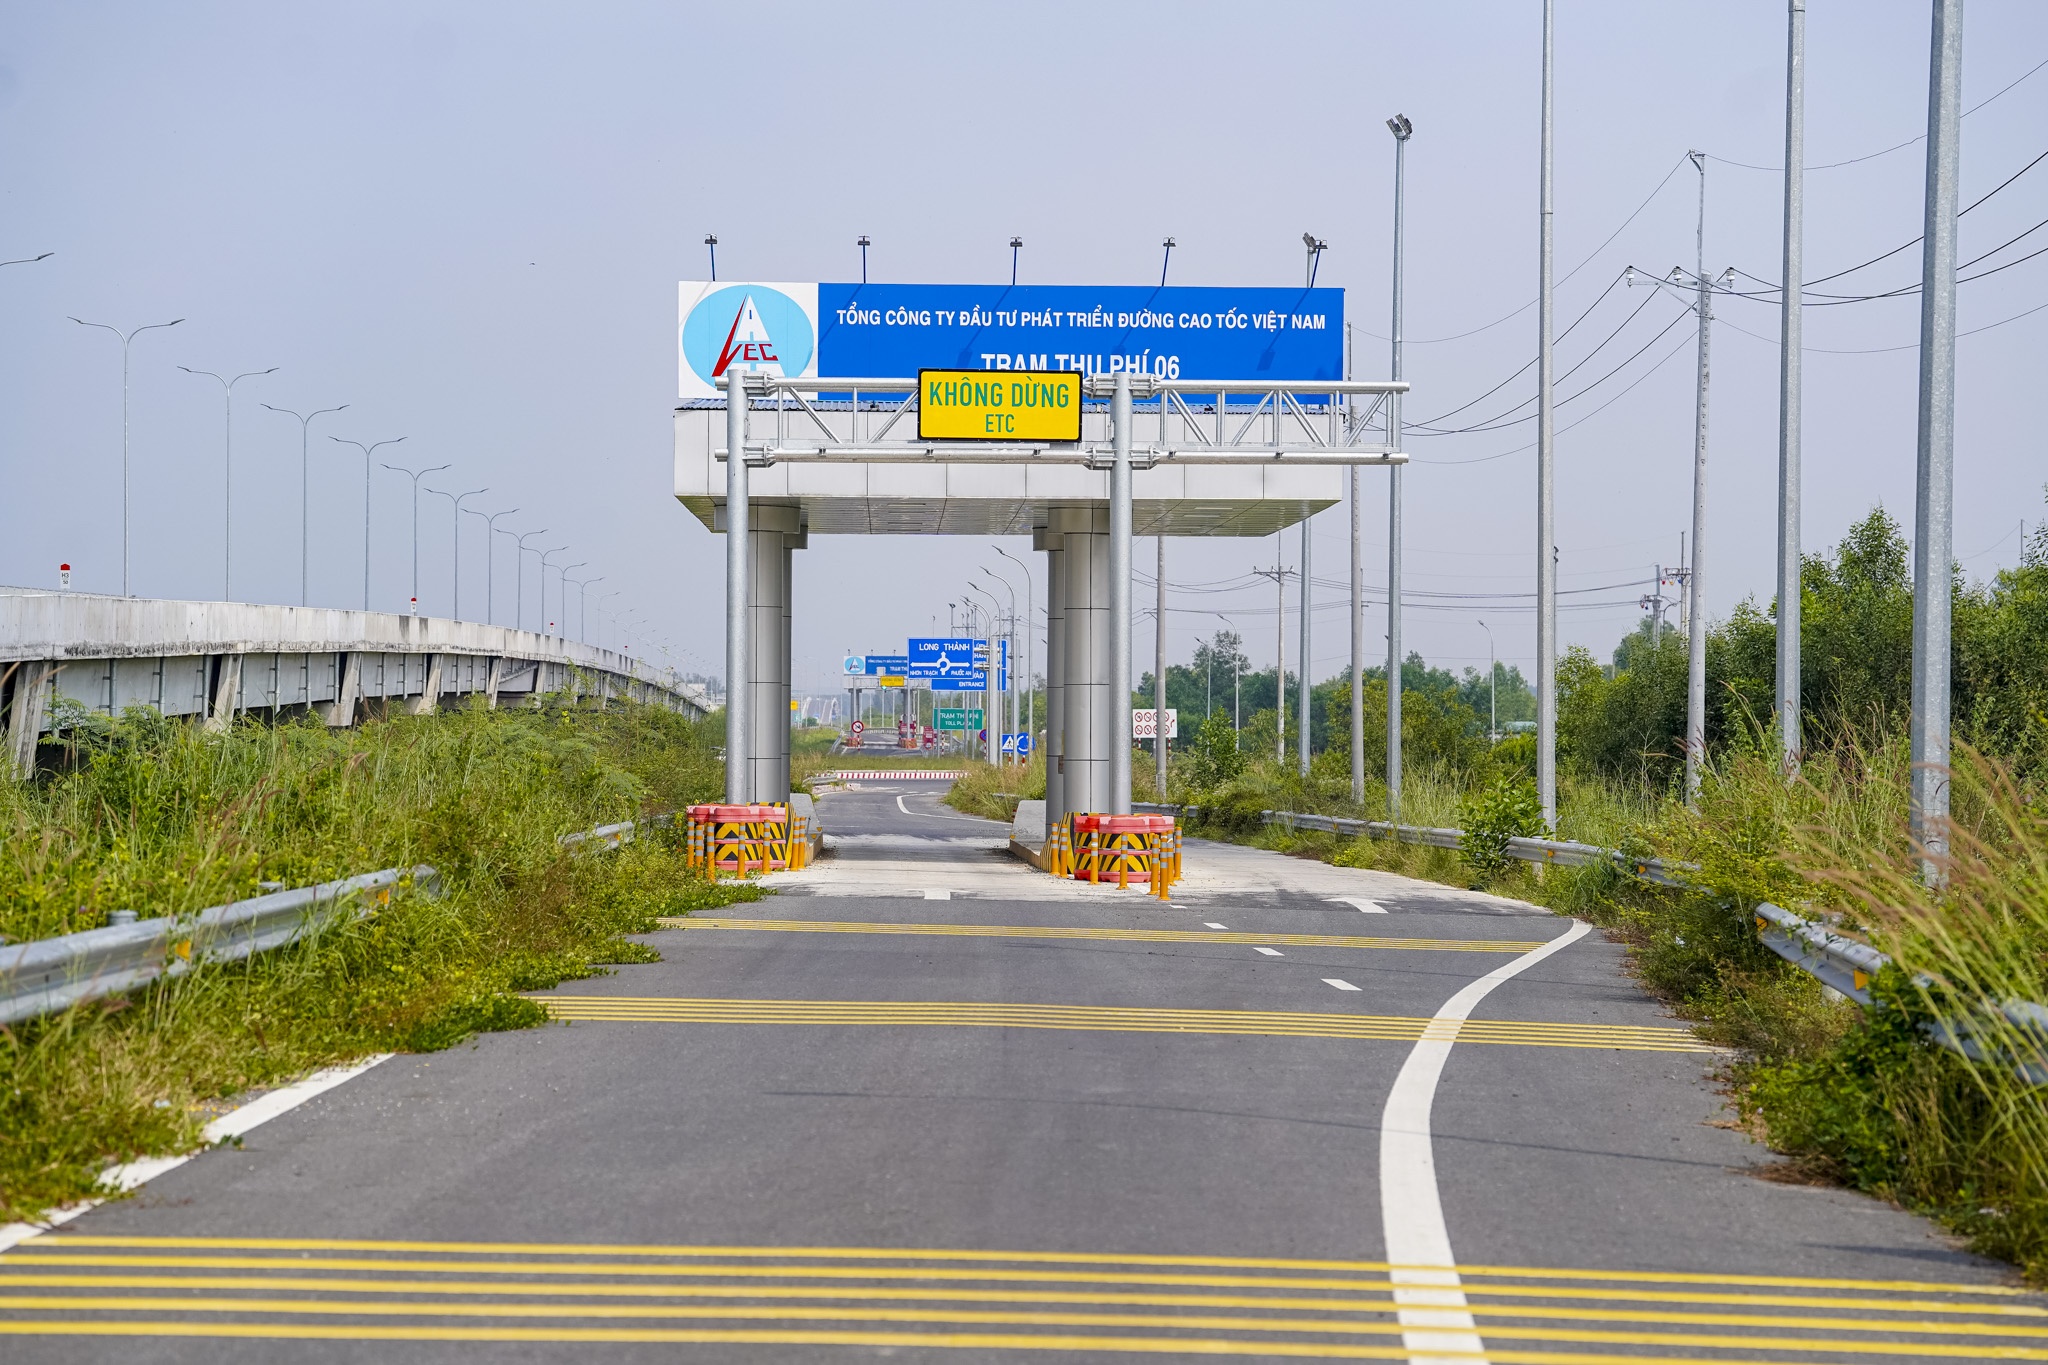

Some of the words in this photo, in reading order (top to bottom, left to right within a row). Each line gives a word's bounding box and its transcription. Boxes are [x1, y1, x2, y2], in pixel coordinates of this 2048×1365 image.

[836, 301, 881, 326] TỔNG
[885, 306, 931, 327] CÔNG
[935, 310, 955, 327] TY
[959, 304, 992, 327] ĐẦU
[996, 309, 1018, 328] TƯ
[1021, 308, 1063, 328] PHÁT
[1067, 304, 1114, 328] TRIỂN
[1118, 308, 1174, 329] ĐƯỜNG
[1178, 313, 1212, 330] CAO
[1215, 307, 1248, 330] TỐC
[1252, 310, 1287, 333] VIỆT
[1291, 313, 1326, 330] NAM
[1109, 348, 1150, 376] PHÍ
[1154, 354, 1181, 380] 06
[929, 376, 1003, 407] KHÔNG
[1011, 375, 1069, 408] DỪNG
[985, 413, 1015, 433] ETC
[944, 641, 970, 651] THÀNH
